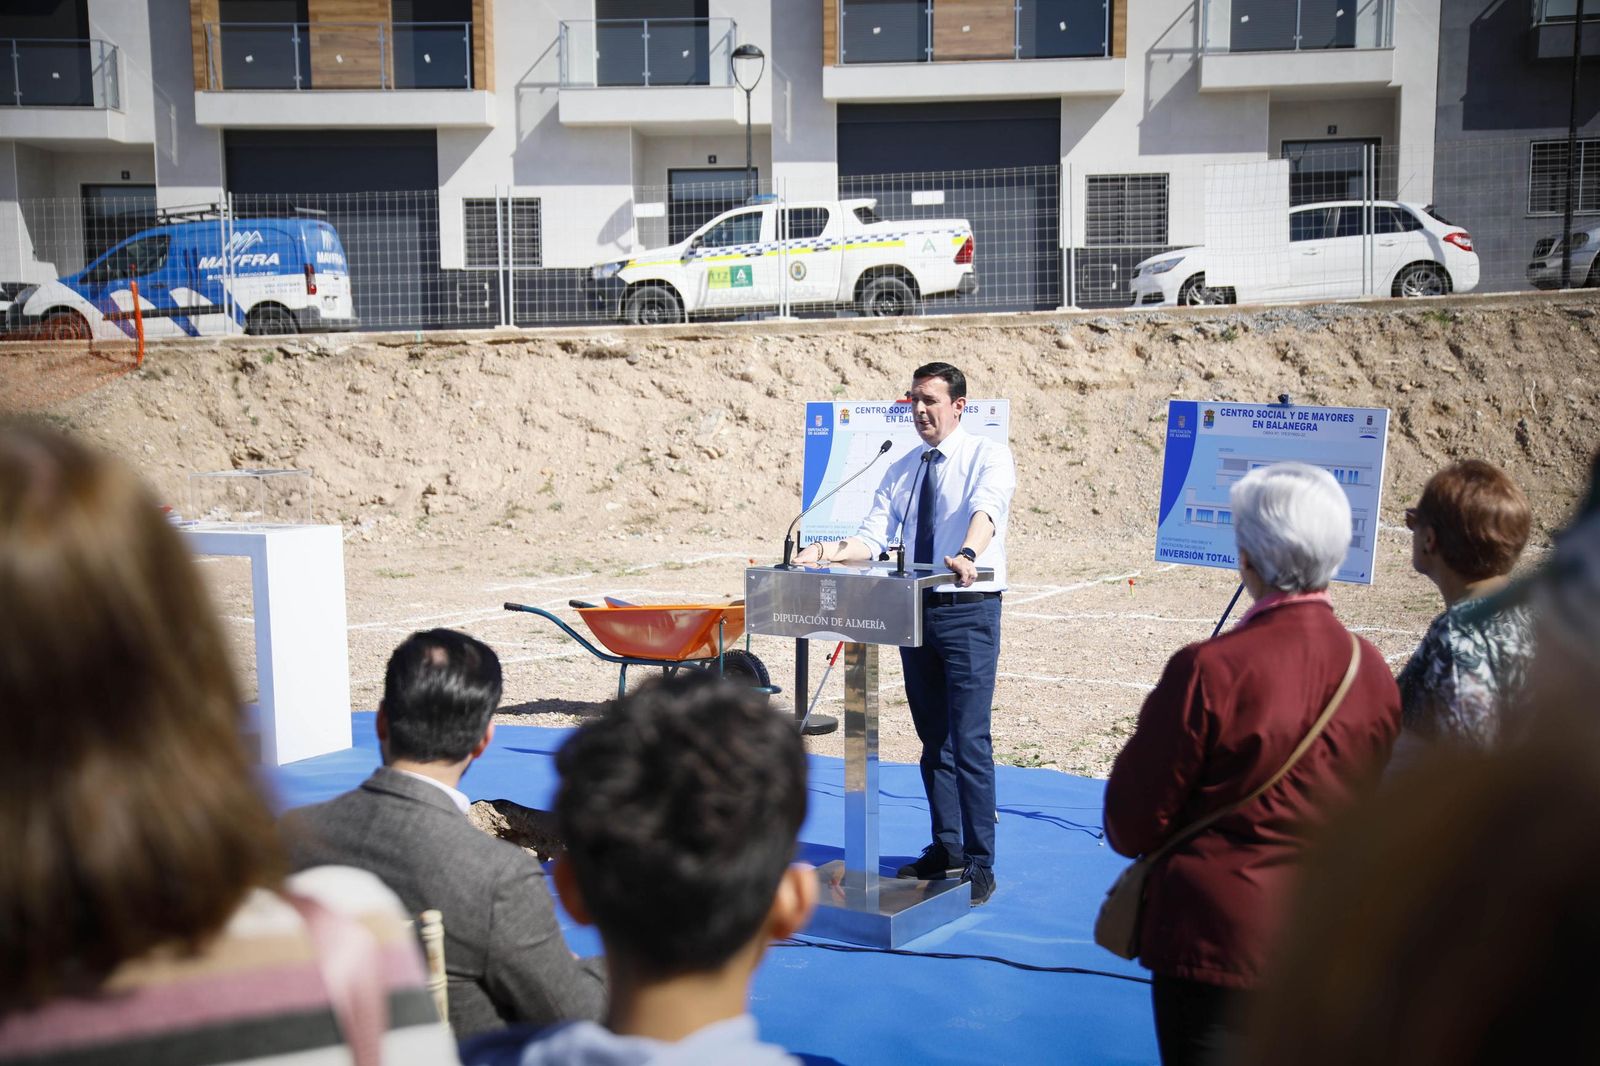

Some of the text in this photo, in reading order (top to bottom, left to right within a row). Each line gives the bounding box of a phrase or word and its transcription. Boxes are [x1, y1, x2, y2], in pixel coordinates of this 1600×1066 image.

[199, 253, 279, 269] MAYFRA
[855, 406, 912, 414] CENTRO SOCIA
[1220, 408, 1354, 423] CENTRO SOCIAL Y DE MAYORES
[1252, 420, 1318, 432] EN BALANEGRA
[1206, 553, 1235, 564] TOTAL:
[773, 613, 886, 630] DIPUTACIÓN DE ALMERÍA
